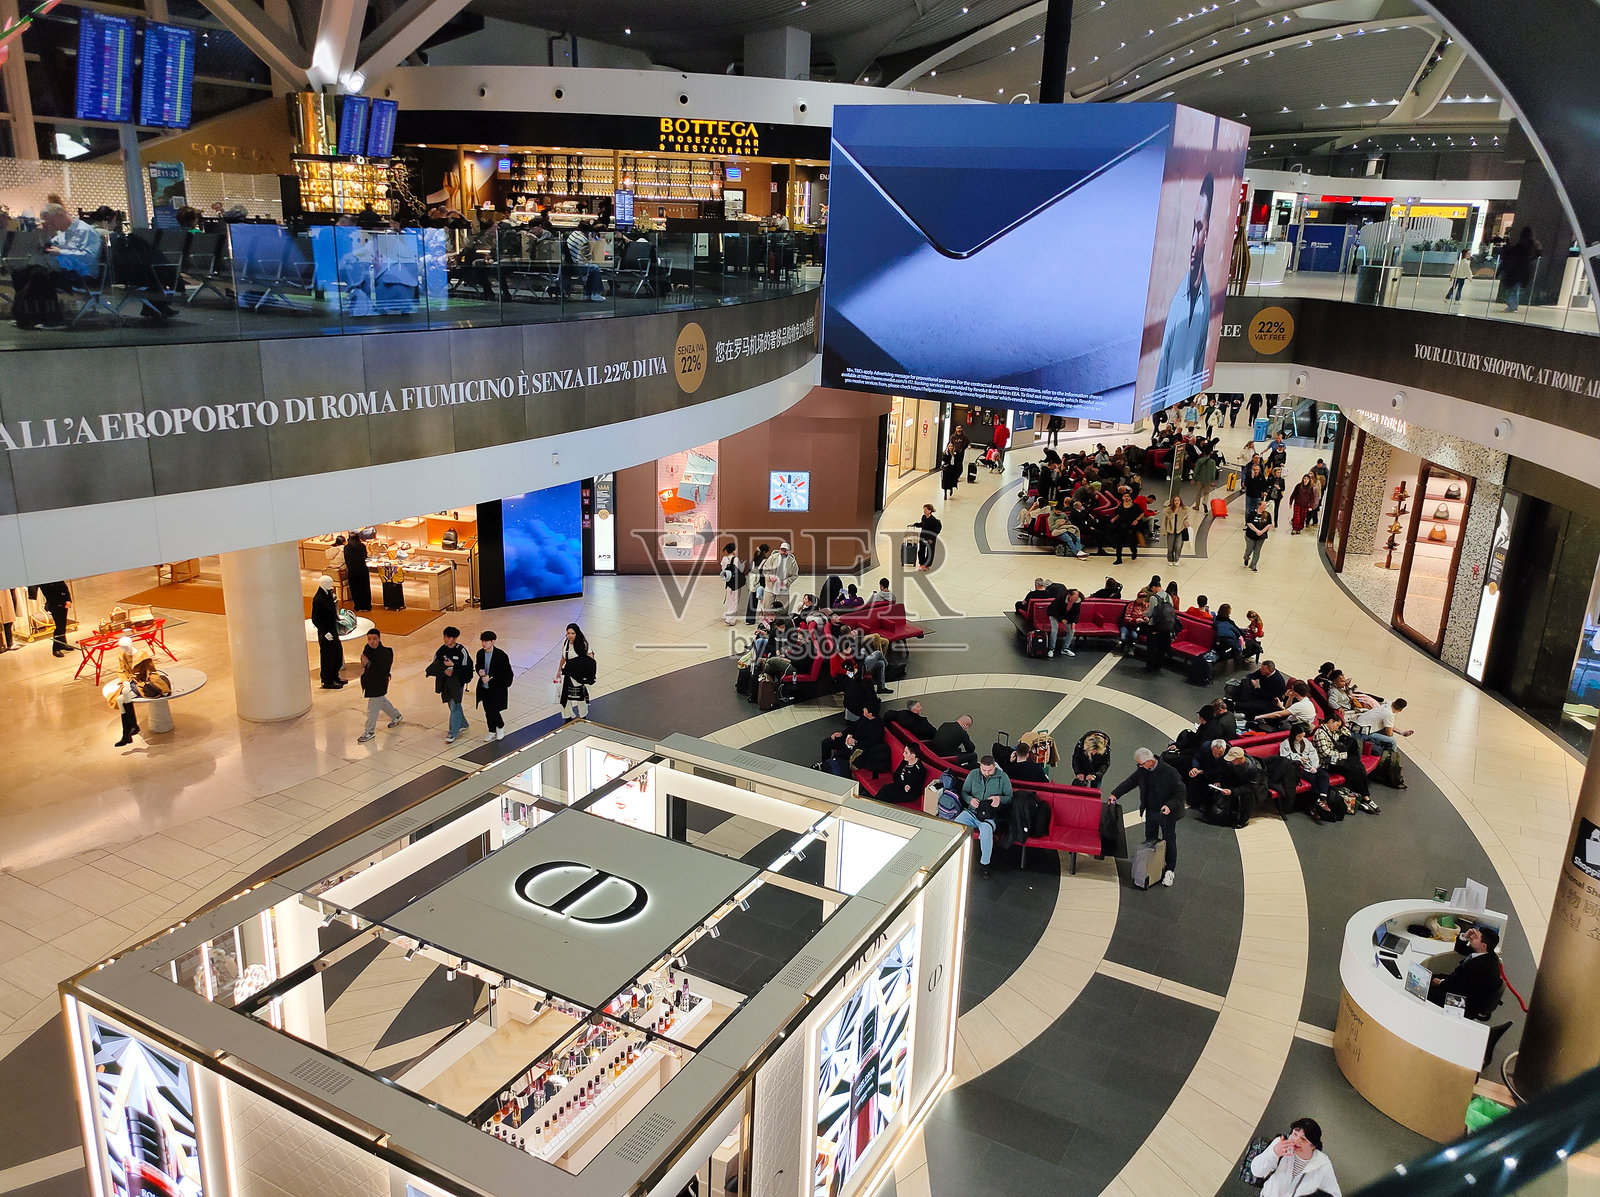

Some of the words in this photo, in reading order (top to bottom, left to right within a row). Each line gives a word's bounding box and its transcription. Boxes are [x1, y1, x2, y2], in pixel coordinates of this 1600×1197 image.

[99, 14, 127, 24] Departures
[660, 118, 759, 138] BOTTEGA
[660, 135, 728, 145] PROSECCO
[736, 138, 759, 147] BAR
[675, 144, 759, 155] RESTAURANT
[1257, 321, 1285, 334] 22%
[677, 344, 695, 355] SENZA
[696, 343, 704, 352] IVA
[681, 354, 702, 374] 22%
[1414, 343, 1441, 363] YOUR
[1441, 348, 1483, 371] LUXURY
[1482, 356, 1535, 383] SHOPPING
[1534, 368, 1552, 386] AT
[1551, 370, 1586, 394] ROME
[283, 397, 316, 425] DI
[320, 390, 398, 420] ROMA
[401, 376, 514, 411] FIUMICINO
[518, 370, 530, 395] È
[532, 366, 586, 394] SENZA
[586, 361, 603, 386] IL
[604, 360, 631, 385] 22%
[632, 357, 648, 379] DI
[649, 355, 668, 376] IVA
